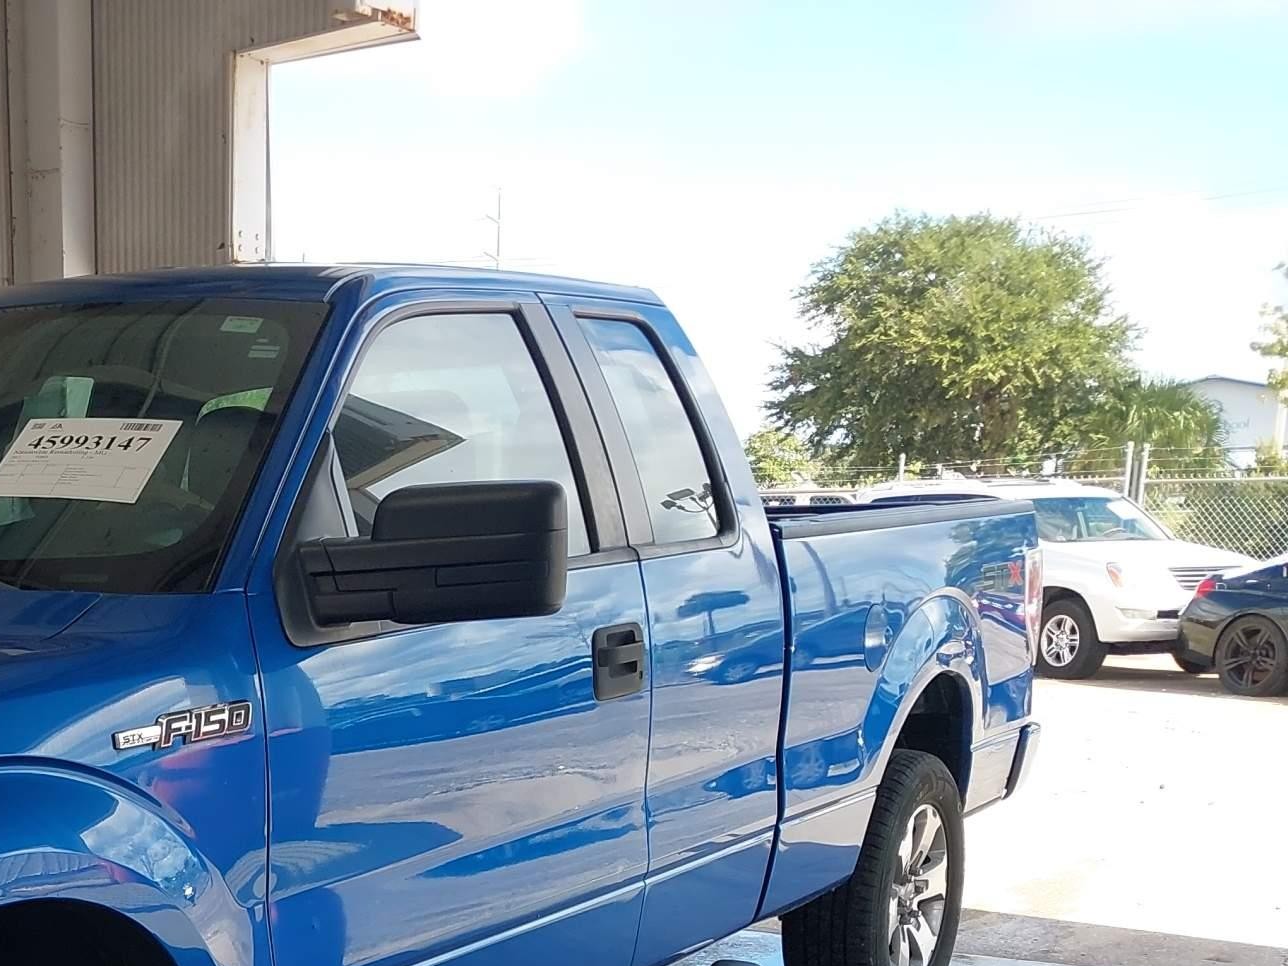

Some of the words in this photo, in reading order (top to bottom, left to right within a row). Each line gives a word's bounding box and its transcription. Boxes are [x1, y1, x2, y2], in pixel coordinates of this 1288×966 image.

[28, 435, 152, 452] 45993147
[160, 701, 253, 748] F-150
[122, 732, 144, 744] STX
